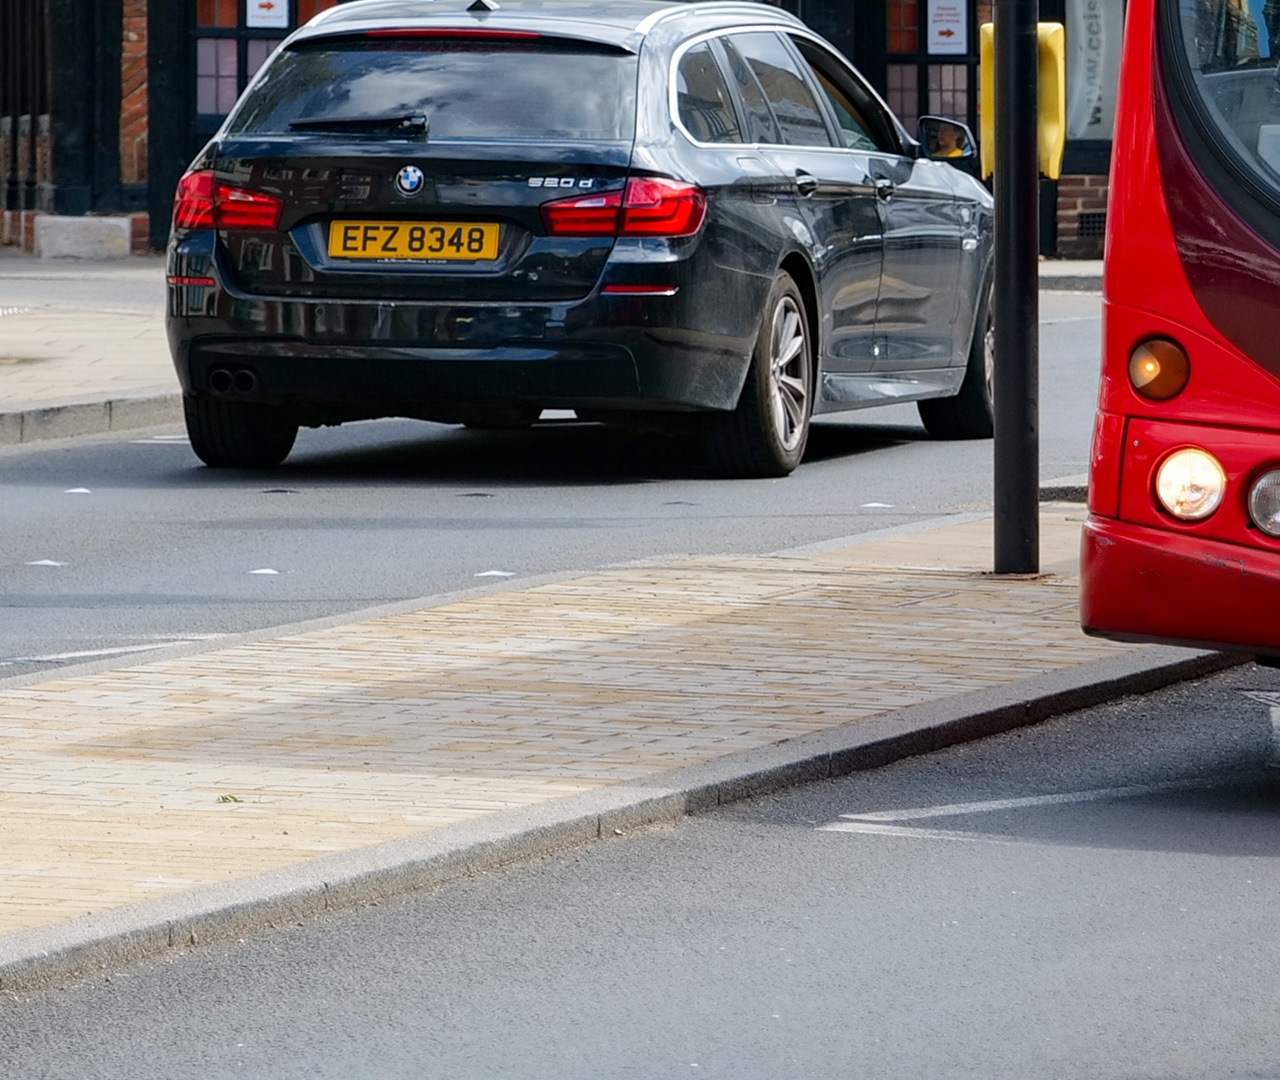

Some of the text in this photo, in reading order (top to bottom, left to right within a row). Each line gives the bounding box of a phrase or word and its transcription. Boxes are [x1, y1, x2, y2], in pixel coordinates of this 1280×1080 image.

[528, 177, 594, 188] 520 d
[342, 225, 485, 253] EFZ 8348
